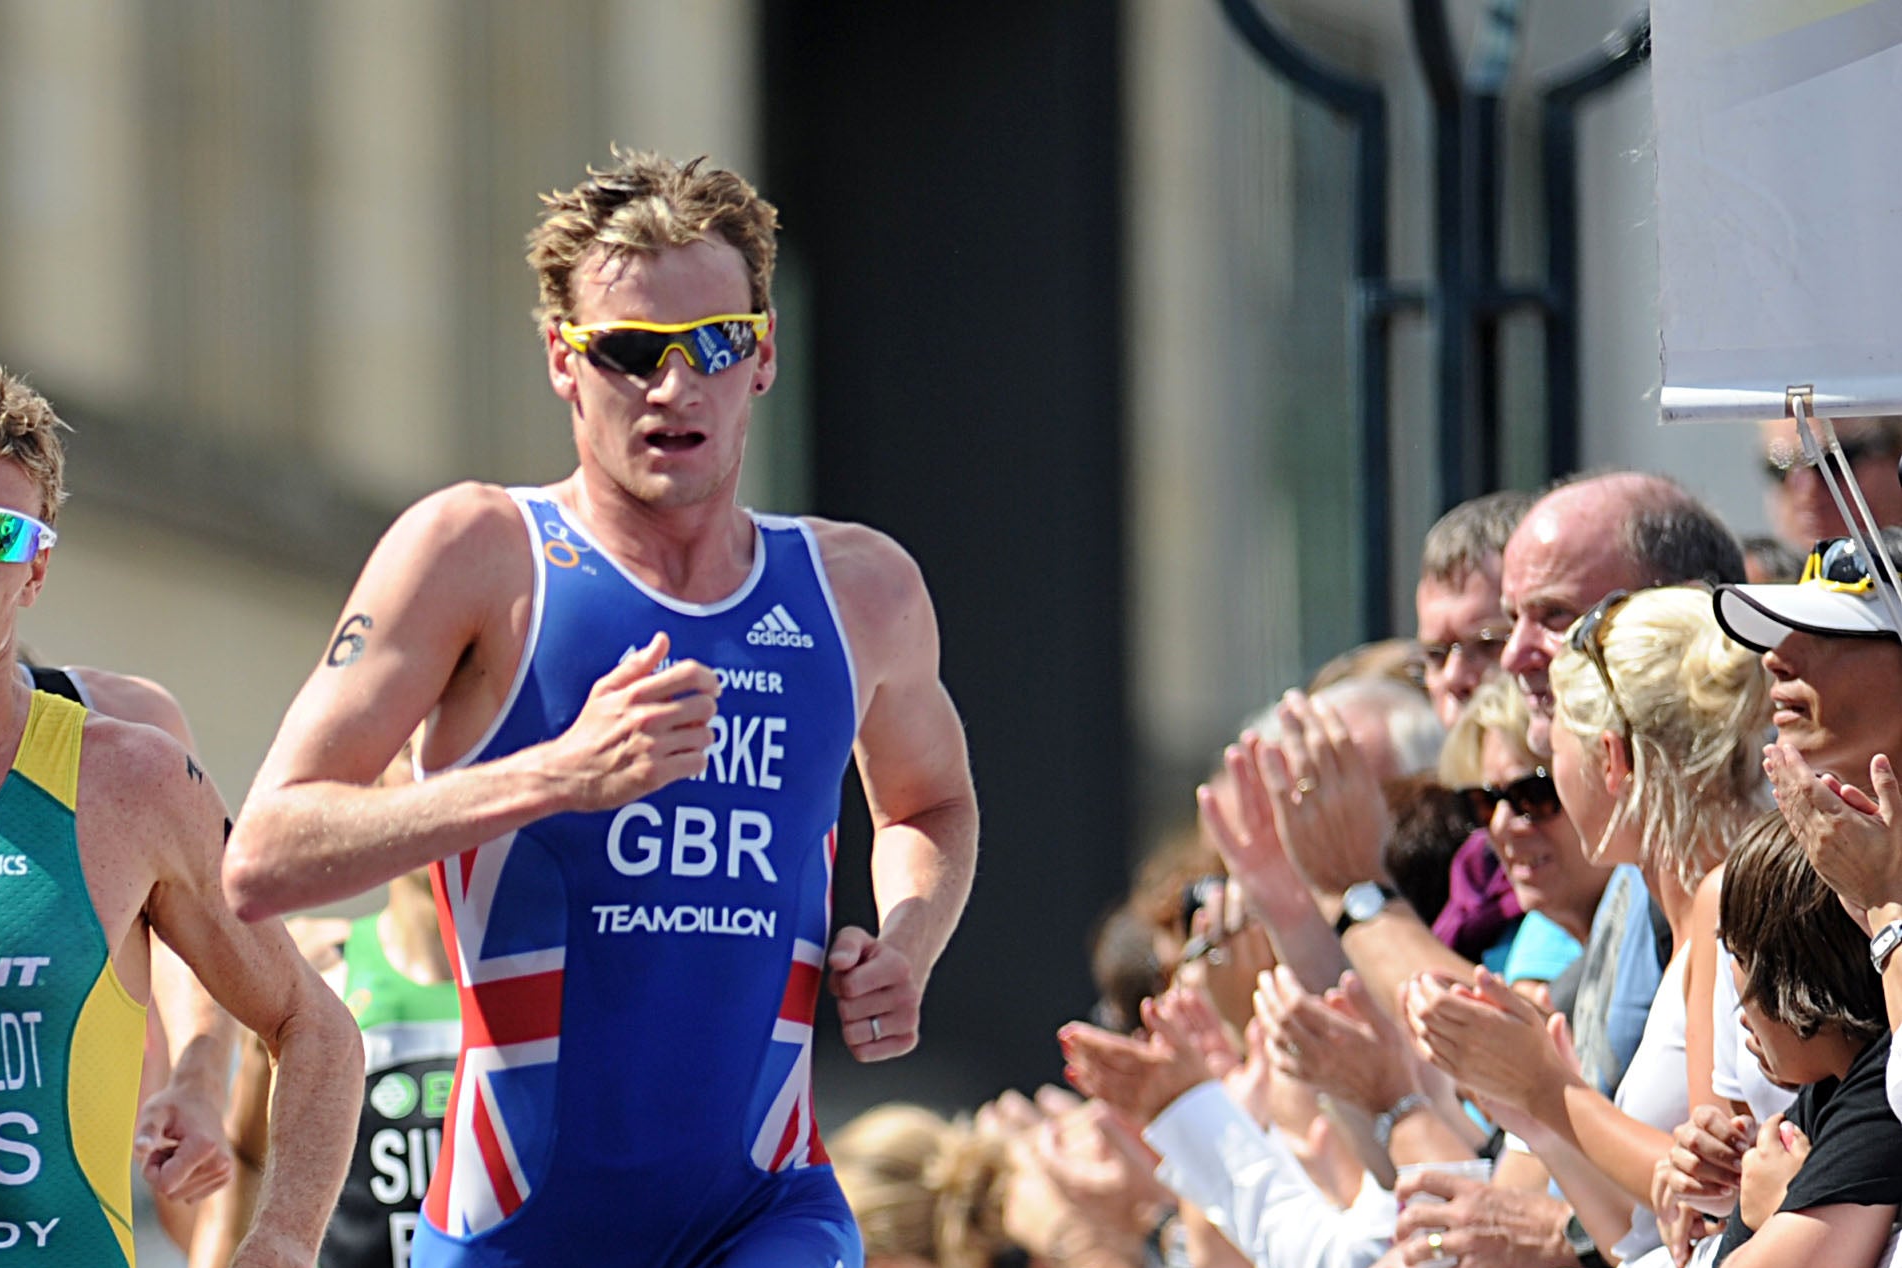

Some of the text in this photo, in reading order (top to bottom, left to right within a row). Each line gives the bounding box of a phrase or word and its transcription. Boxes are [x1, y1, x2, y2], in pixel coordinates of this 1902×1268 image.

[327, 613, 373, 667] 6
[746, 632, 814, 649] adidas
[688, 714, 788, 791] RKE
[607, 802, 778, 883] GBR
